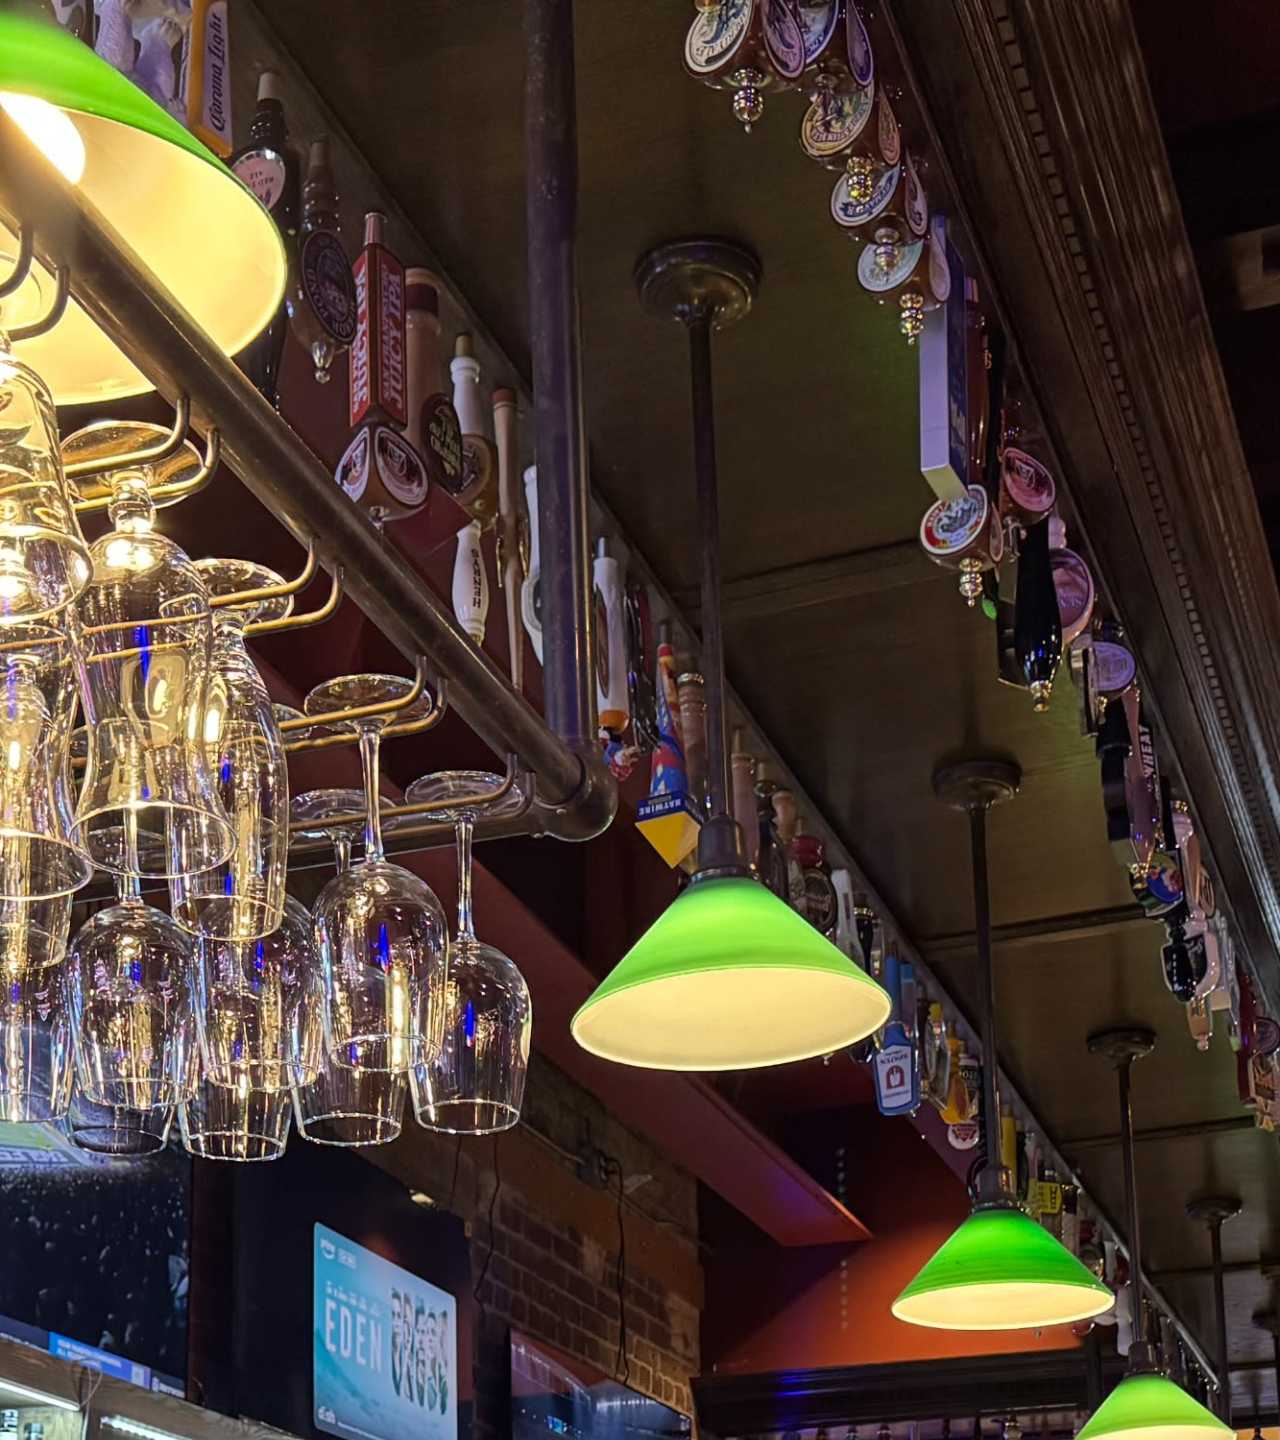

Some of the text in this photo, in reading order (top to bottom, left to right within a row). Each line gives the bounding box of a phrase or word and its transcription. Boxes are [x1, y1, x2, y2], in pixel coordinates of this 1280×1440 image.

[208, 14, 224, 63] Light
[1138, 724, 1154, 776] WHEAT
[324, 1297, 383, 1373] EDEN
